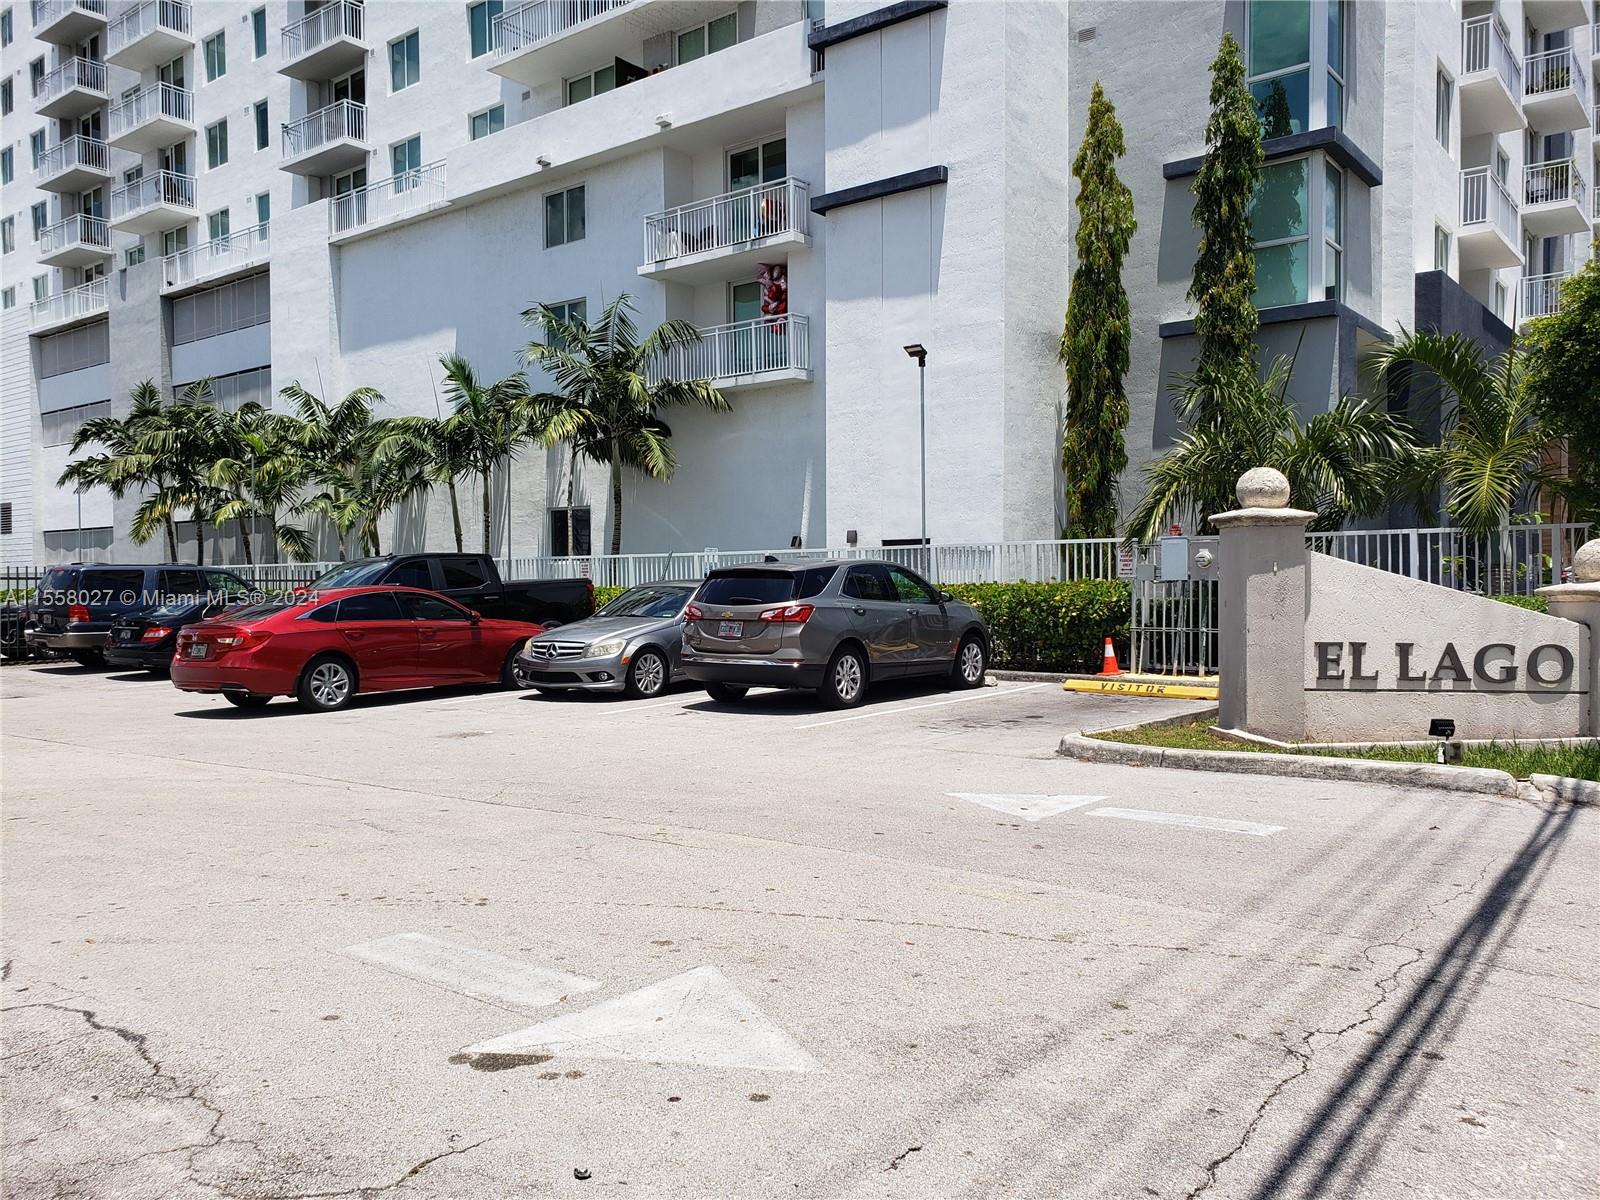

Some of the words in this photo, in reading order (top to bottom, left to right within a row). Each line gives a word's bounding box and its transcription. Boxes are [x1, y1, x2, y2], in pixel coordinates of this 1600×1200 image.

[1314, 641, 1379, 680] EL
[1395, 642, 1575, 684] LAGO
[1101, 682, 1167, 694] VISITOR
